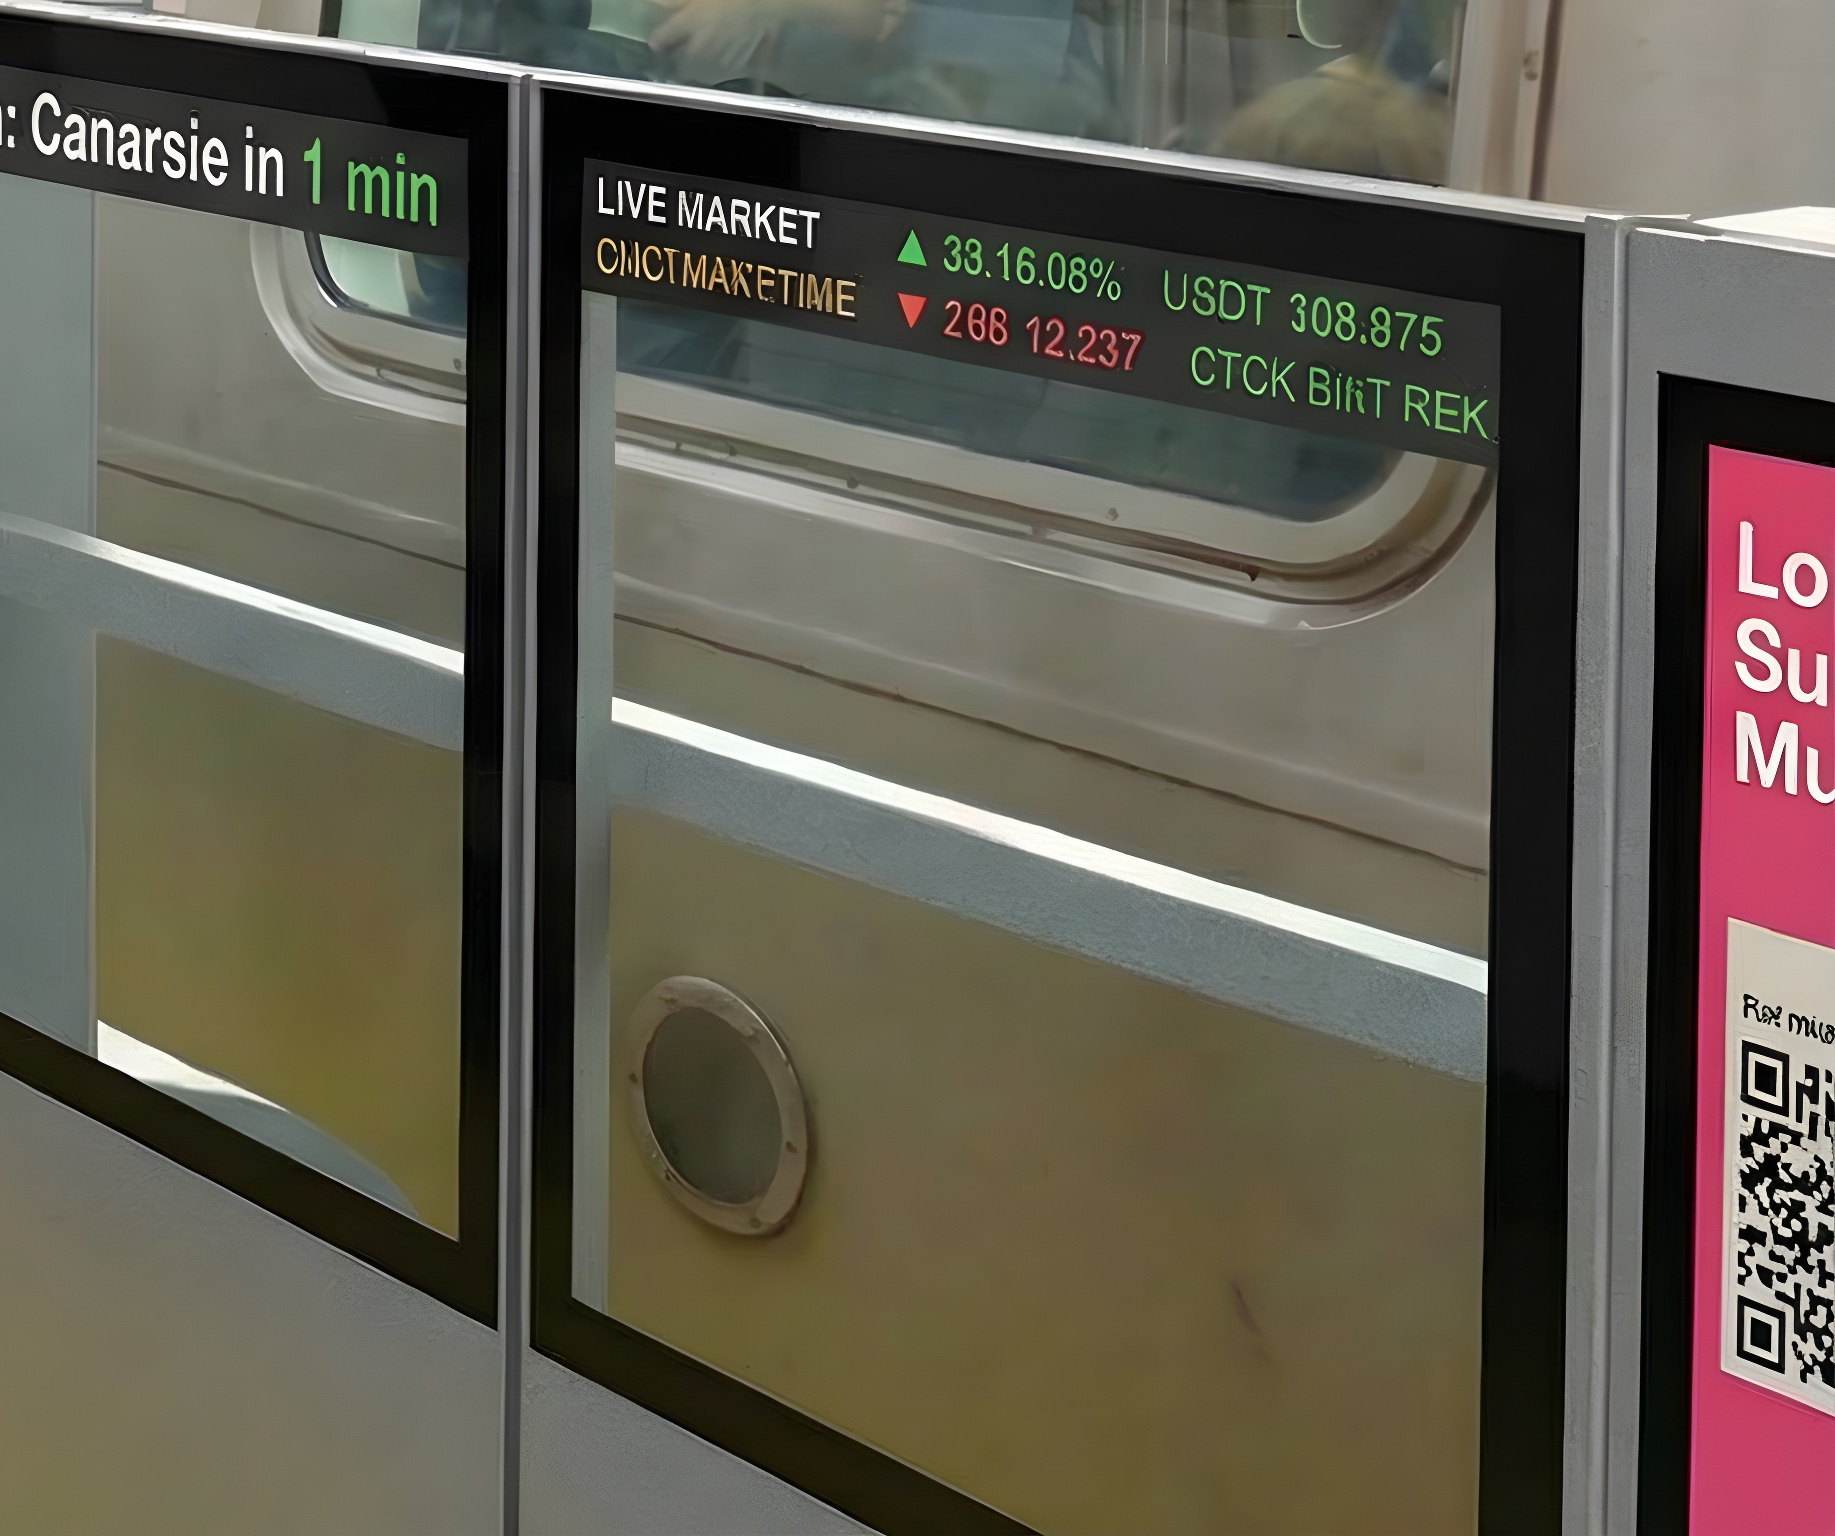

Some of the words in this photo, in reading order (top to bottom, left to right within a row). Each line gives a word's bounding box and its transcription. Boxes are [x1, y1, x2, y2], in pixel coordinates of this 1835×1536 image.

[32, 91, 229, 187] Canarsie
[244, 125, 285, 198] in
[303, 136, 322, 205] 1
[347, 152, 438, 228] min
[598, 176, 667, 224] LIVE
[678, 190, 821, 249] MARKET
[1164, 269, 1271, 325] USDT
[1191, 346, 1296, 402] CTCK
[1404, 384, 1490, 440] REK
[1738, 520, 1829, 608] Lo
[1735, 617, 1828, 707] Su
